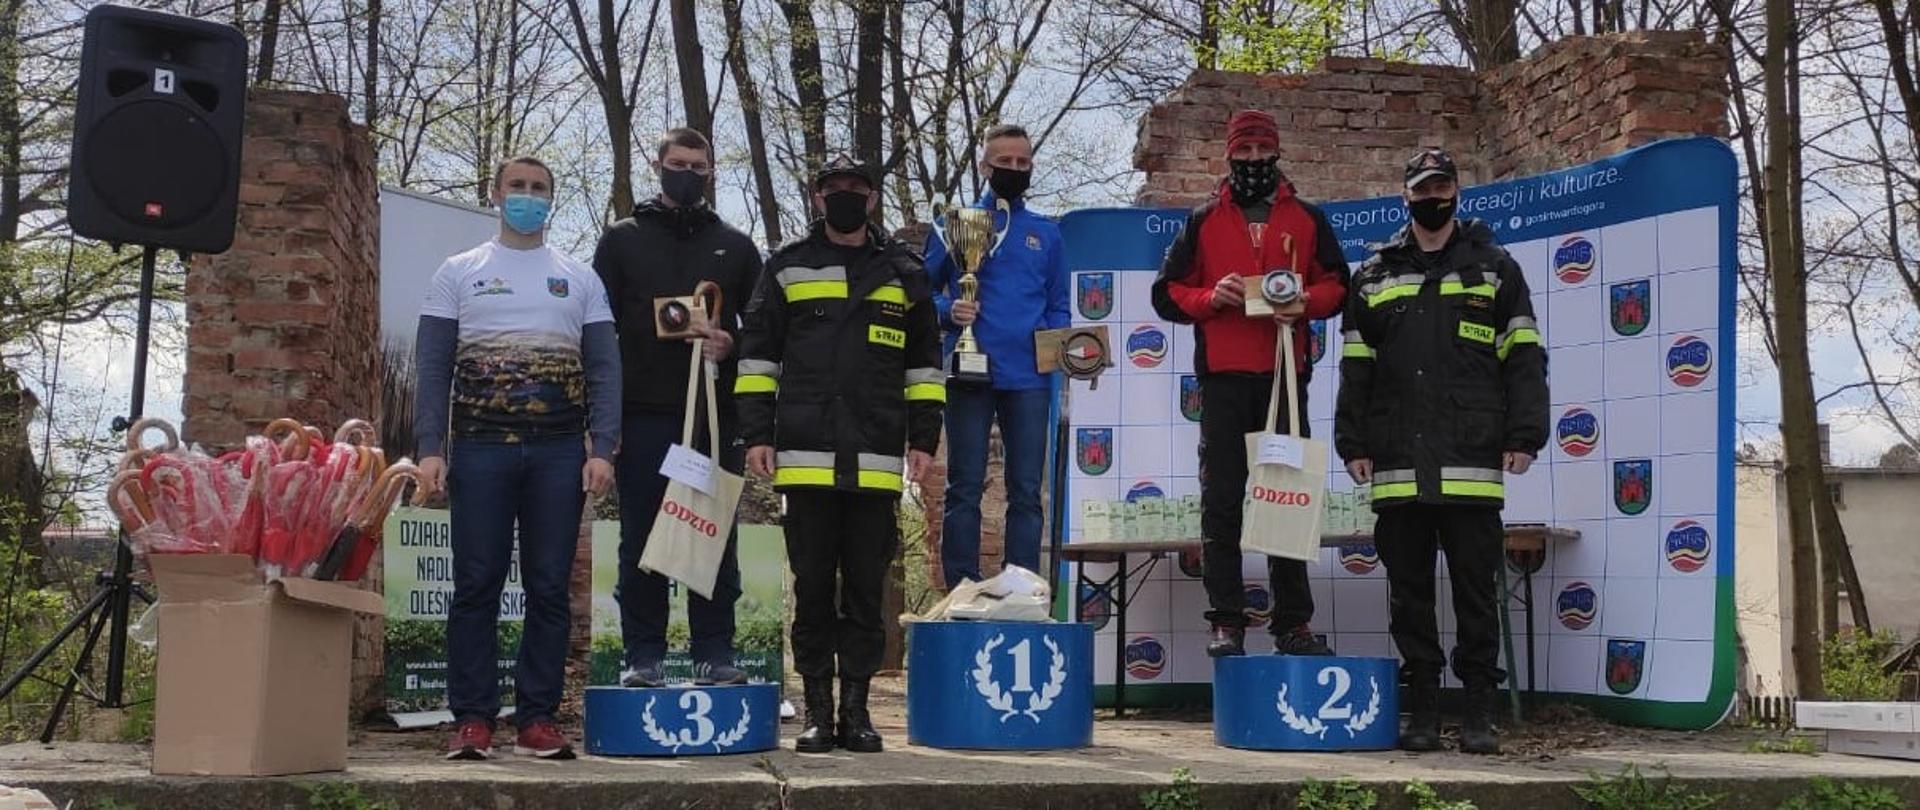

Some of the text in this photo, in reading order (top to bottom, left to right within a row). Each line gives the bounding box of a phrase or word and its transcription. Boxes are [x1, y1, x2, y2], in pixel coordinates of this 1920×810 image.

[1457, 186, 1524, 214] kreacji
[401, 520, 449, 547] DZIAŁA
[1007, 638, 1034, 692] 1
[679, 690, 715, 747] 3
[1317, 666, 1353, 719] 2
